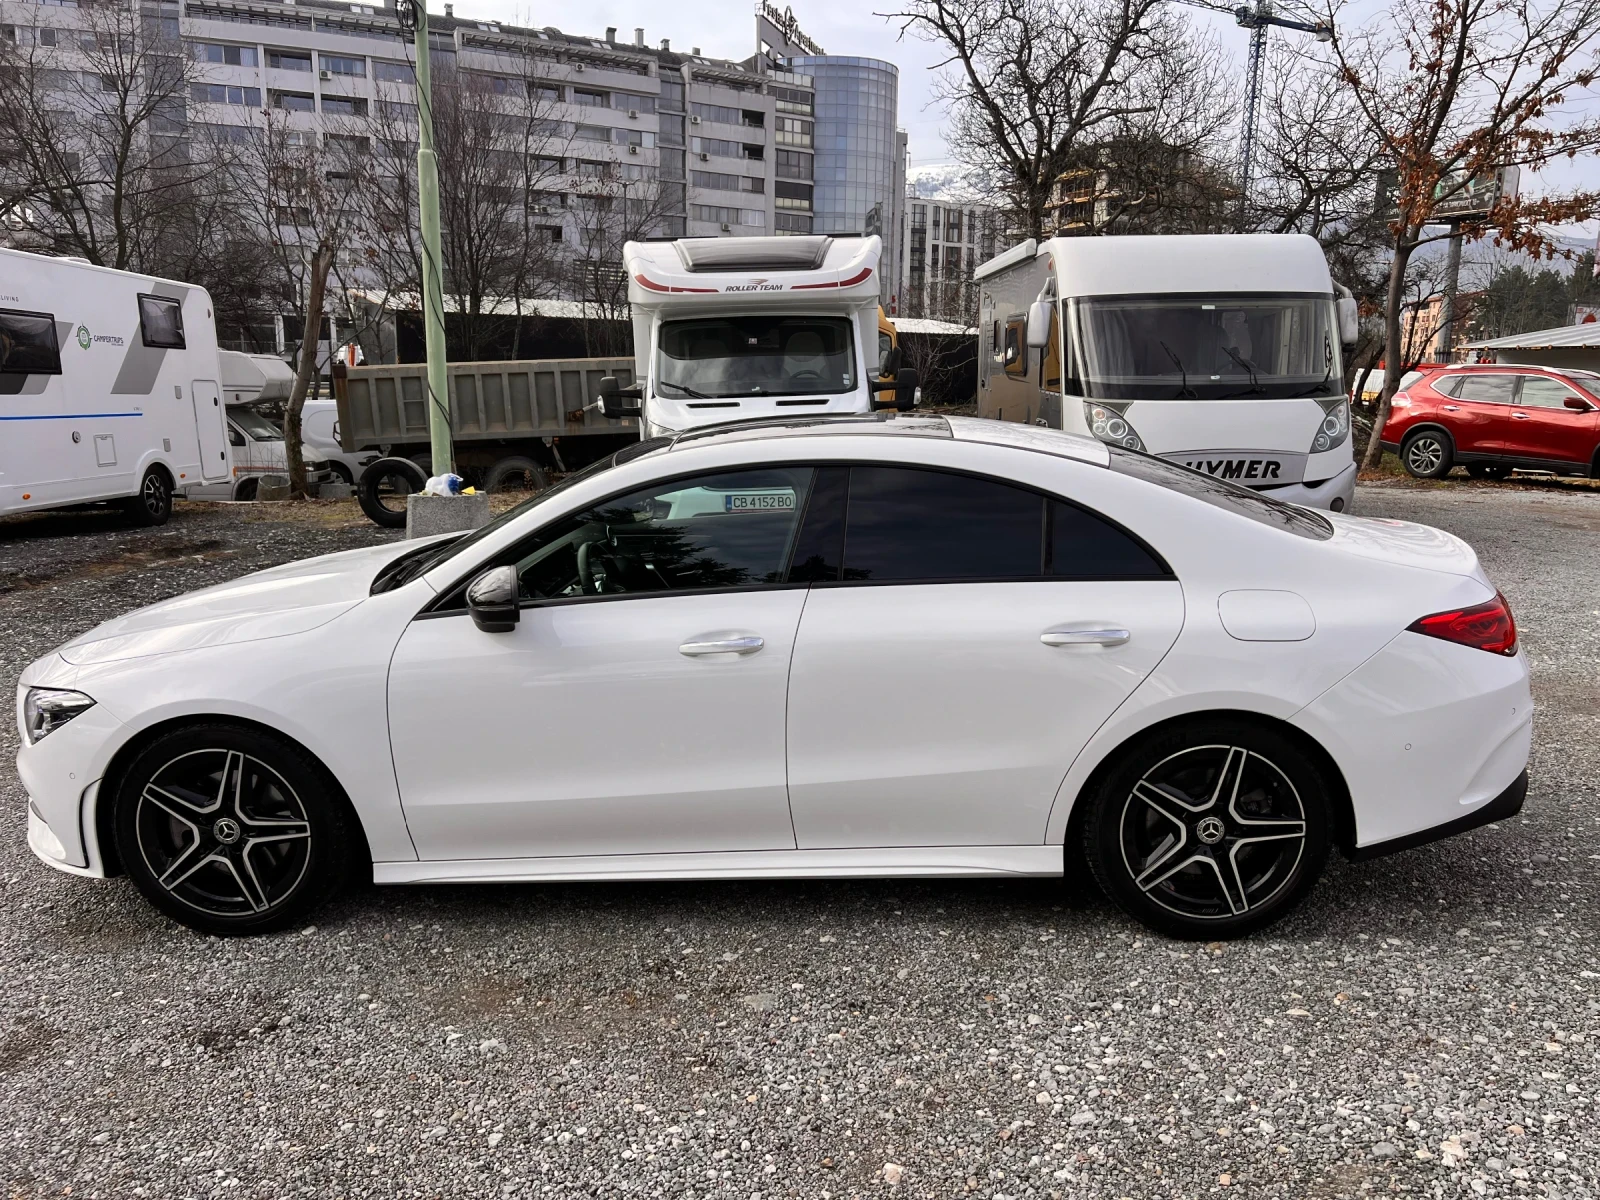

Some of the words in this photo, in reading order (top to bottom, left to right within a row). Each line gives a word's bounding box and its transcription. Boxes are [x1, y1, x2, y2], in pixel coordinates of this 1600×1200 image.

[733, 497, 748, 508] CB
[750, 496, 776, 508] 4152
[777, 496, 792, 507] BO
